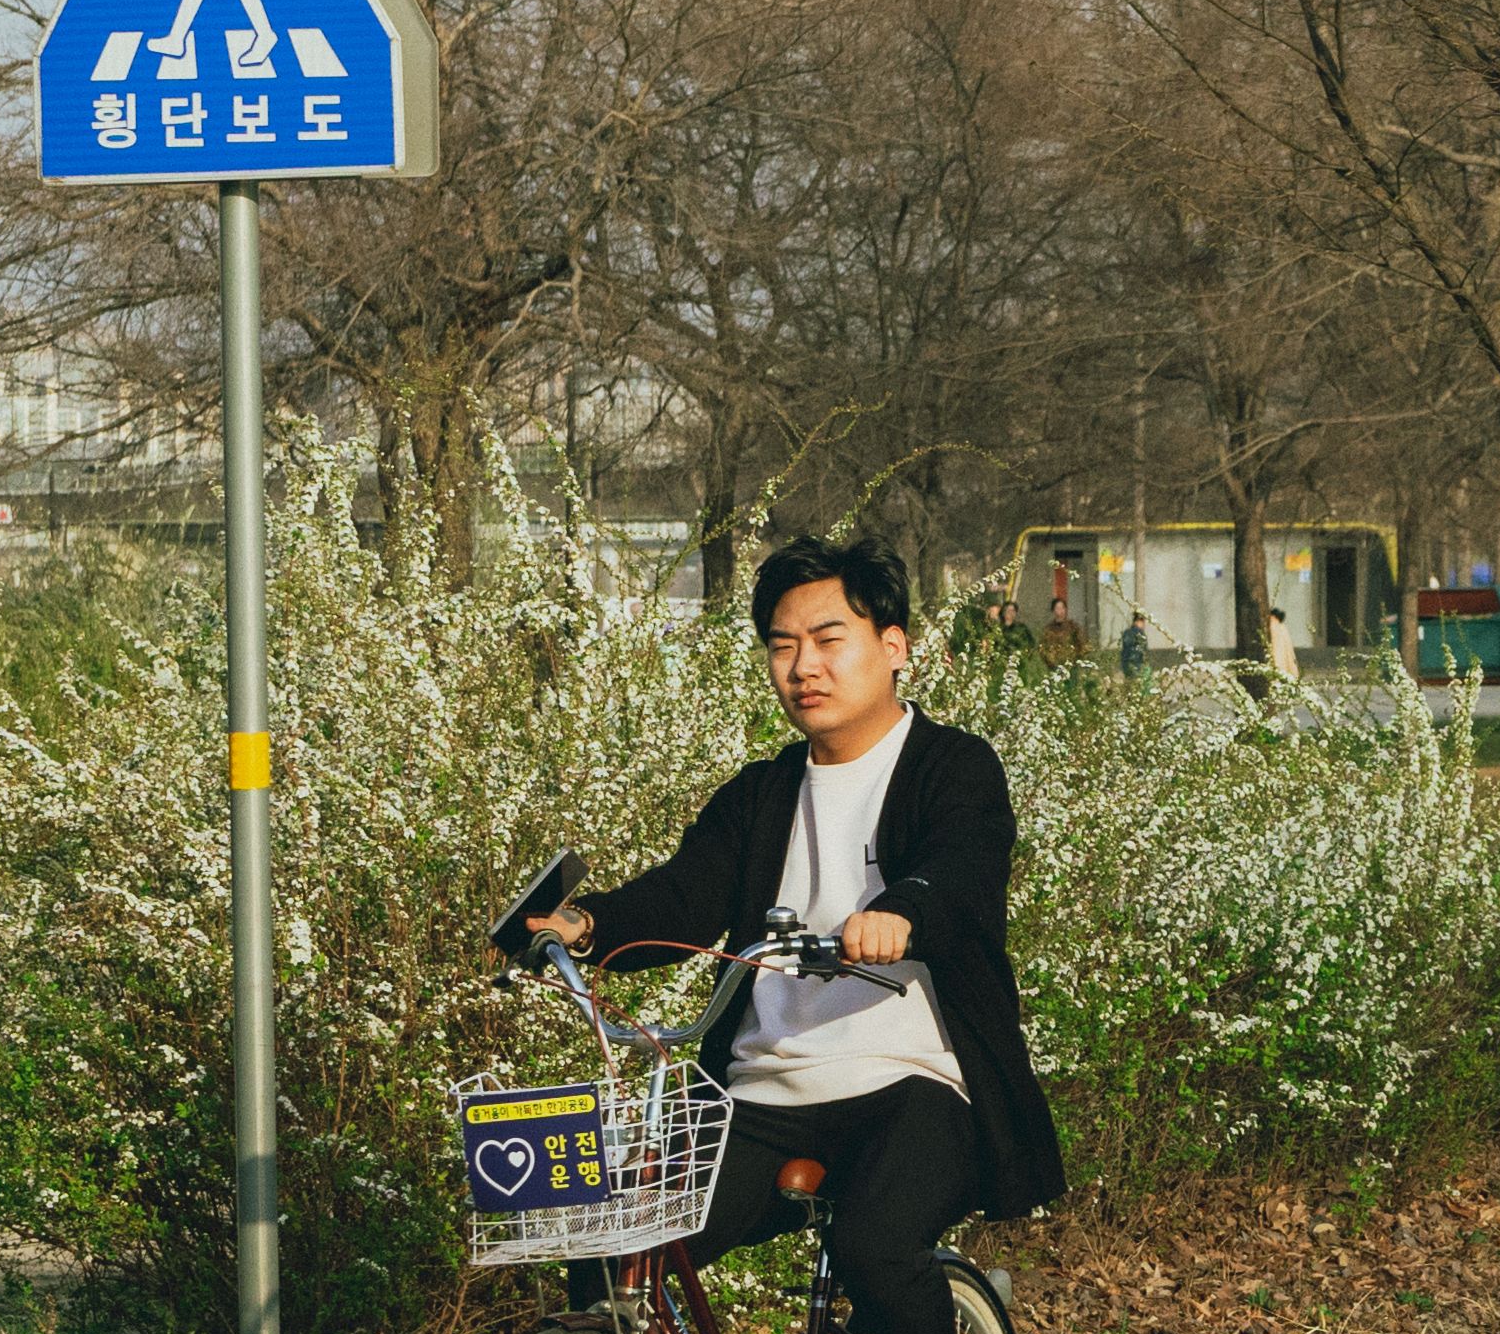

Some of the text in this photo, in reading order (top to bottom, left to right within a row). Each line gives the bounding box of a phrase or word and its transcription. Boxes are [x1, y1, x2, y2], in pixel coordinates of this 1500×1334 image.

[91, 92, 348, 148] 횡단보도
[472, 1097, 589, 1121] 즐거움이 가득한 한강공원
[544, 1131, 598, 1159] 안전
[550, 1160, 601, 1189] 운행
